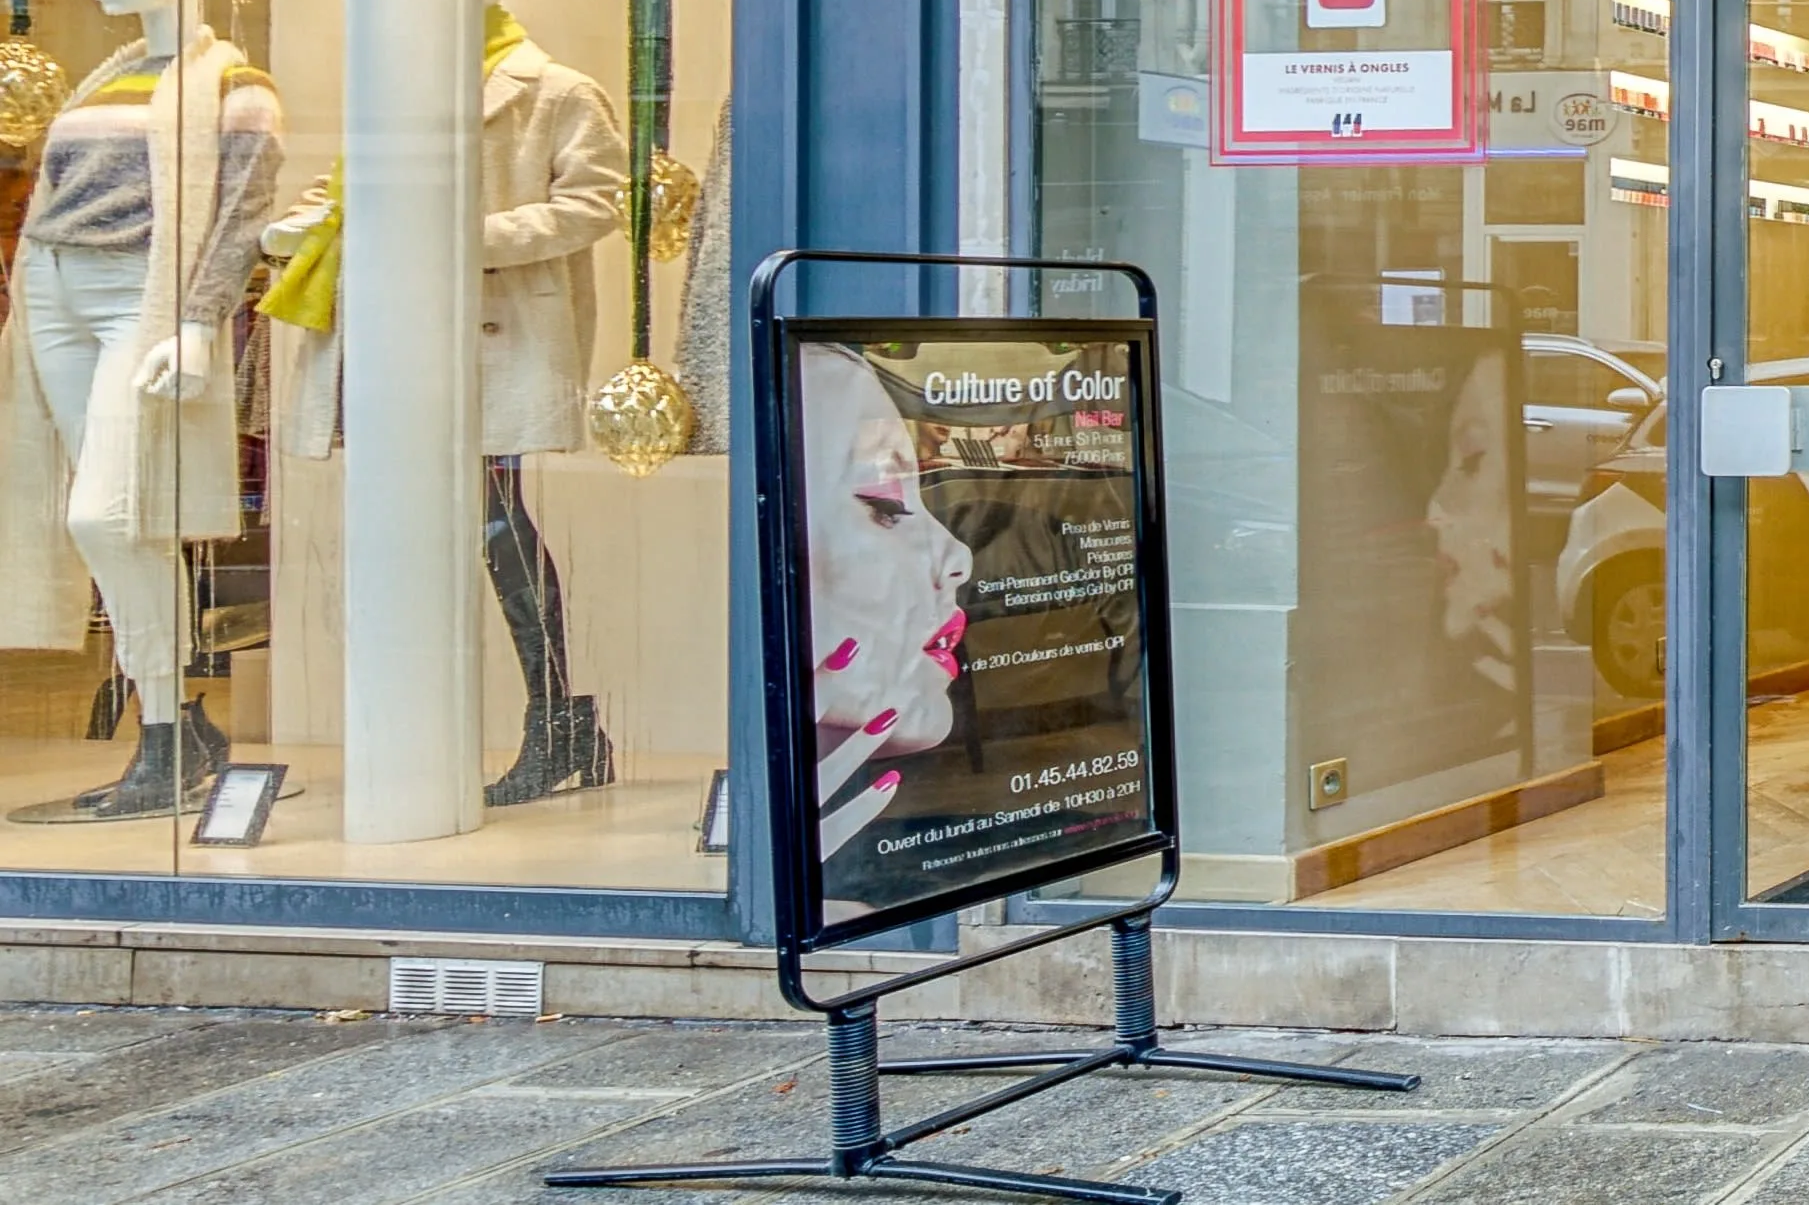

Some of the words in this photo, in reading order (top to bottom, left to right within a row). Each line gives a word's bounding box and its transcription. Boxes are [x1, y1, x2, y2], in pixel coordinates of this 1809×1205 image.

[1285, 64, 1297, 74] LE
[1300, 64, 1345, 74] VERNIS
[1348, 61, 1357, 73] À
[1360, 63, 1410, 73] ONGLES
[924, 371, 1022, 404] Culture
[1029, 370, 1057, 402] of
[1062, 369, 1126, 401] Color
[1074, 410, 1100, 428] Nail
[1101, 409, 1124, 426] Bar
[1033, 434, 1050, 448] 51
[1064, 449, 1100, 465] 75006
[1088, 520, 1102, 532] de
[1104, 518, 1130, 531] Vernis
[1080, 535, 1132, 549] Manucures
[978, 574, 1058, 593] Semi-Permanent
[1103, 566, 1115, 580] By
[1117, 563, 1134, 575] OPI
[1005, 591, 1052, 606] Extension
[1087, 583, 1104, 595] Gel
[1105, 581, 1116, 595] by
[1117, 578, 1134, 591] OPI
[972, 658, 988, 671] de
[989, 654, 1010, 669] 200
[1012, 647, 1058, 664] Couleurs
[1059, 644, 1074, 658] de
[1075, 639, 1104, 654] vernis
[1105, 636, 1125, 650] OPI
[1010, 749, 1139, 794] 01.45.44.82.59
[877, 831, 921, 855] Ouvert
[924, 827, 944, 843] du
[945, 819, 975, 838] lundi
[976, 815, 993, 830] au
[994, 802, 1041, 826] Samedi
[1042, 799, 1060, 814] de
[1063, 788, 1105, 809] 10H30
[1106, 784, 1115, 799] à
[1116, 780, 1141, 798] 20H
